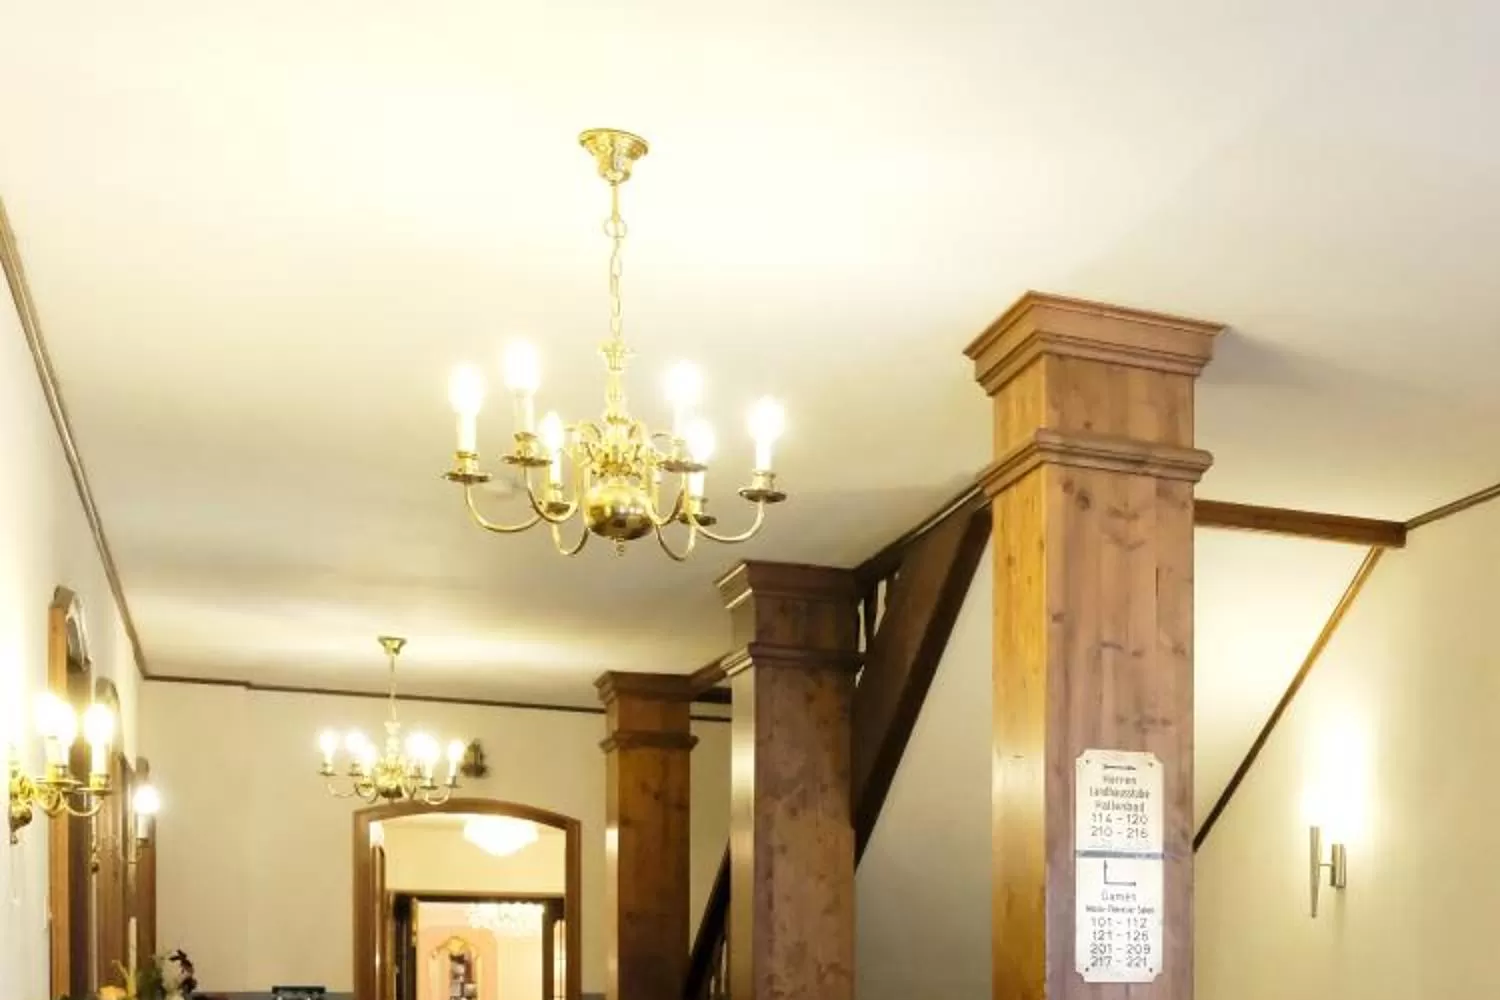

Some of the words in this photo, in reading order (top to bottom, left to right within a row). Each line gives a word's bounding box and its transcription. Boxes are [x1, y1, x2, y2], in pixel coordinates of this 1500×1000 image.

[1127, 814, 1149, 825] 120
[1091, 825, 1113, 837] 210
[1127, 827, 1149, 839] 216
